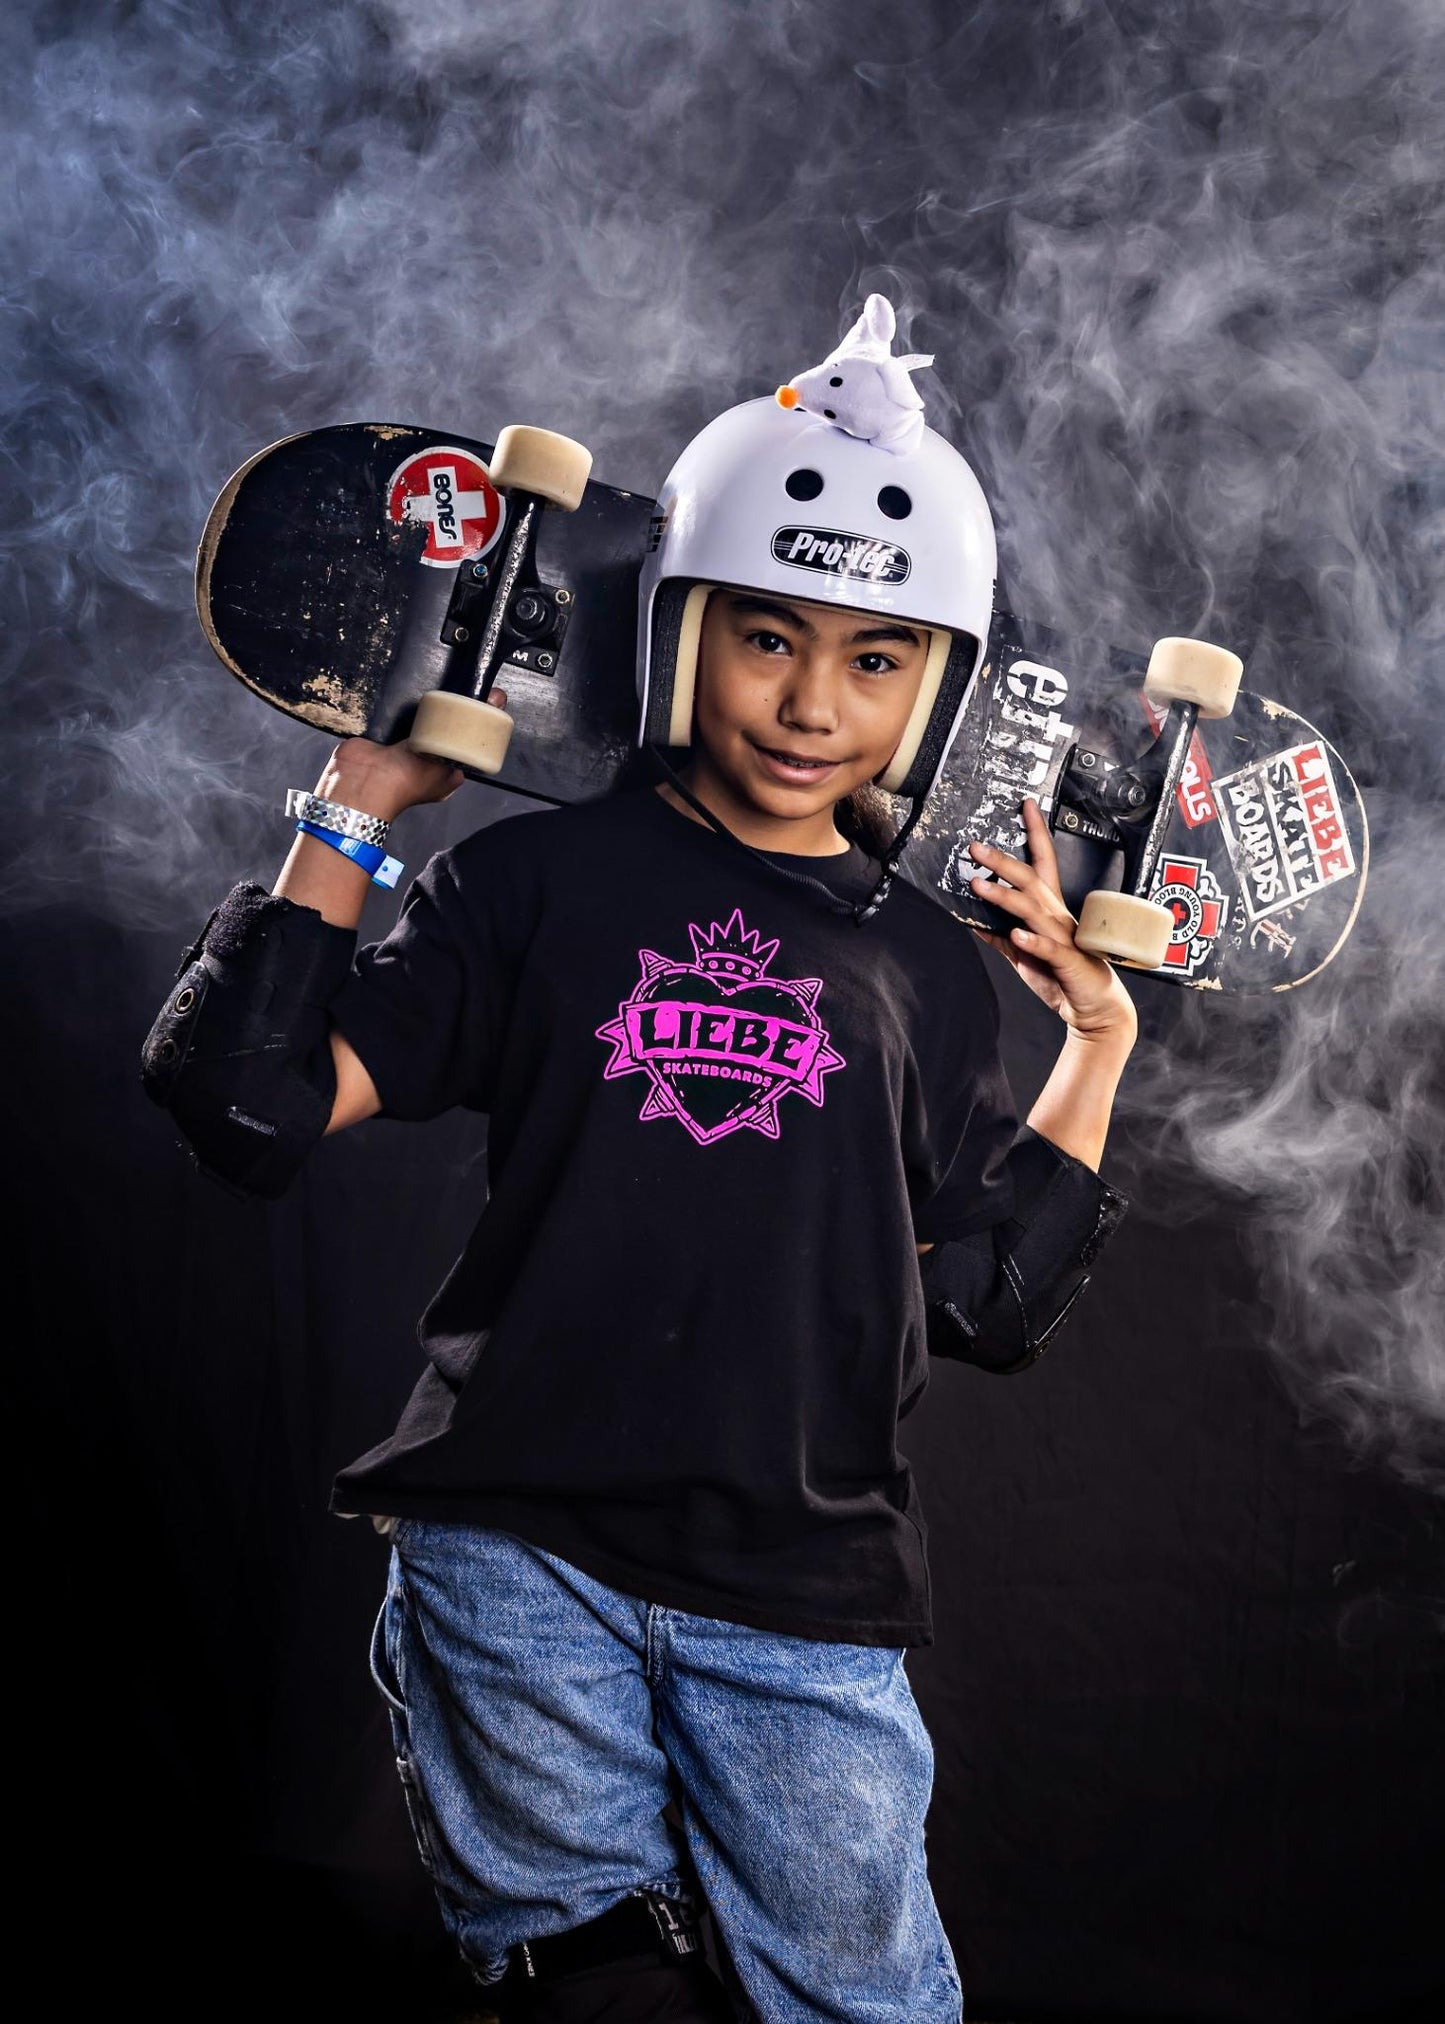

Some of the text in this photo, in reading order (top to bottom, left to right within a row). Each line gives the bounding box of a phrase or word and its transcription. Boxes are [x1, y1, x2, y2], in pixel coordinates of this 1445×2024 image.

[434, 473, 457, 540] BONES
[1228, 778, 1286, 903] BOARDS
[1267, 761, 1319, 894] SKATE
[1291, 746, 1349, 880] LIEBE
[1154, 886, 1200, 917] YOUNG BLOO
[1181, 920, 1198, 938] OLD
[638, 1006, 811, 1071] LIEBE
[662, 1062, 773, 1087] SKATEBOARDS
